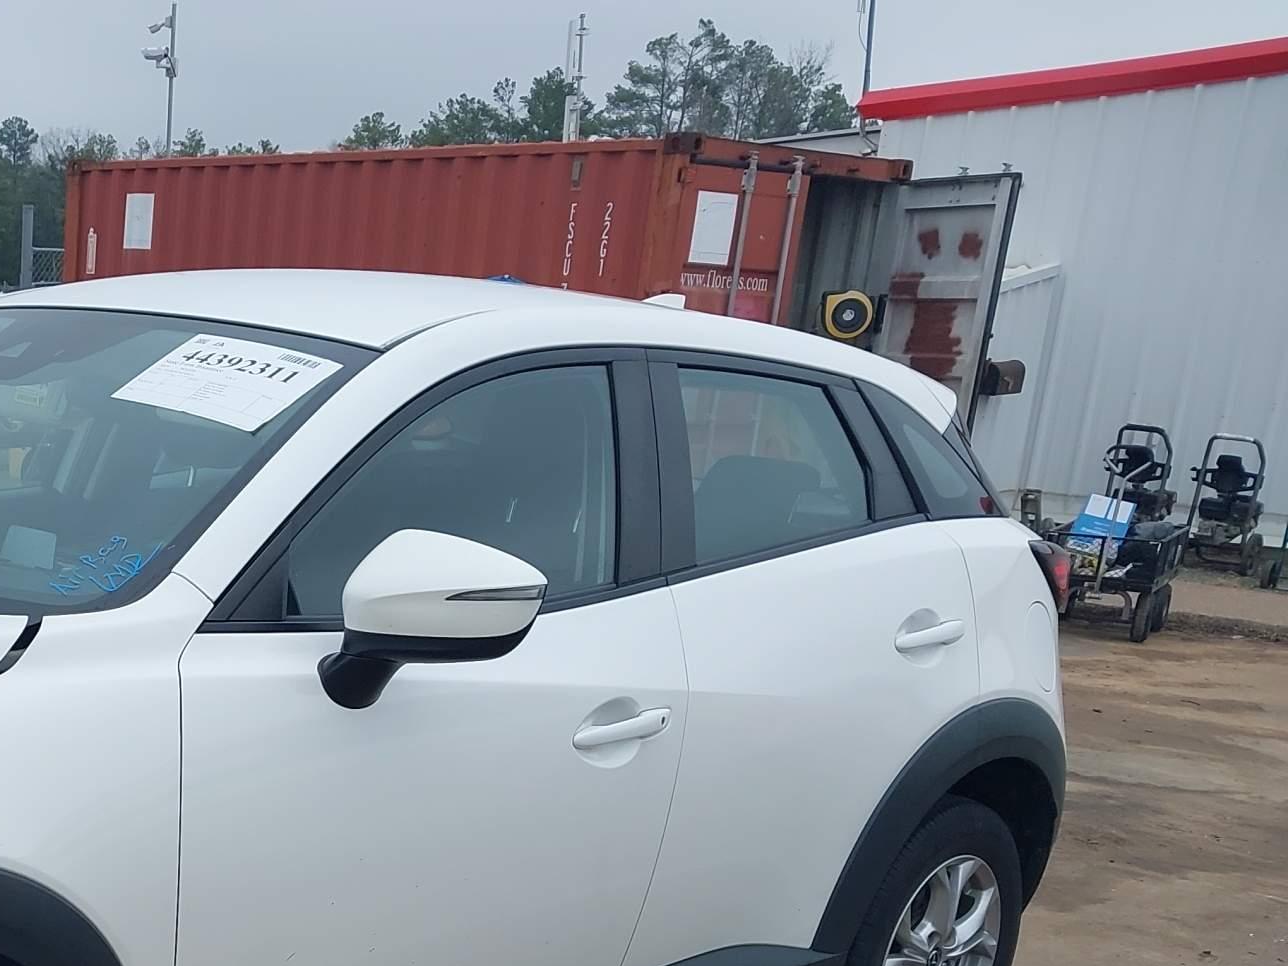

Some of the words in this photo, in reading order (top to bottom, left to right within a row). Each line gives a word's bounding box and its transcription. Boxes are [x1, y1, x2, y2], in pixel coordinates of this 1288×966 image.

[563, 202, 578, 276] FSCU
[598, 202, 614, 277] 22G1
[680, 270, 768, 292] www.flores.com
[182, 350, 300, 384] 44392311
